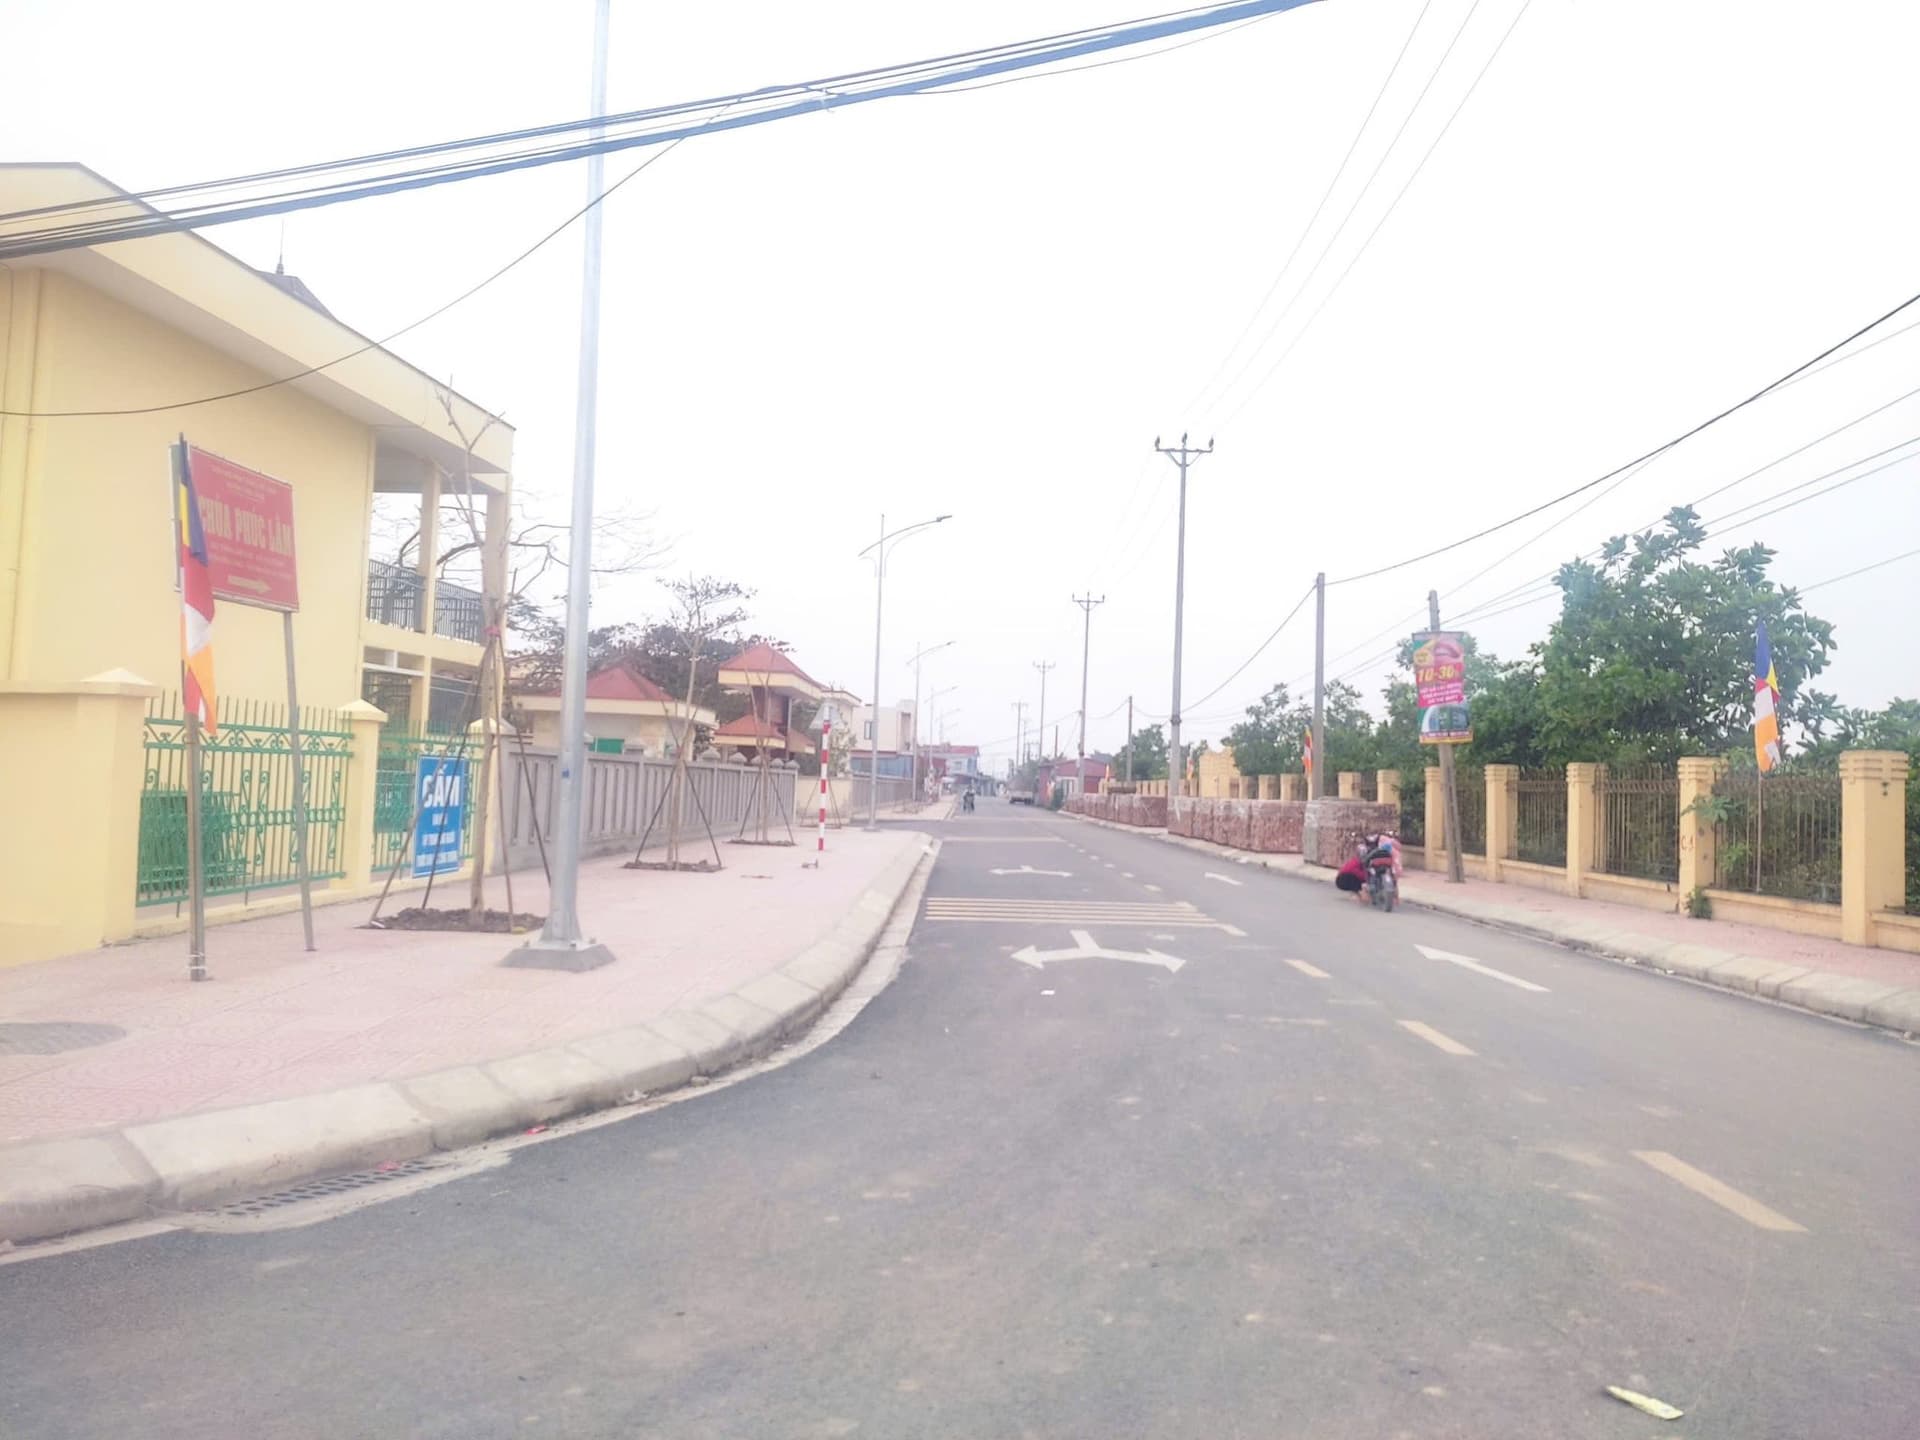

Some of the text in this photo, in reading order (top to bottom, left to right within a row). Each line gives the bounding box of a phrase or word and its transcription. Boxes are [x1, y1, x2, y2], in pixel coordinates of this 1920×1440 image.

[234, 504, 266, 549] PHÚC
[268, 511, 293, 558] LÂM
[422, 764, 460, 808] CẤM
